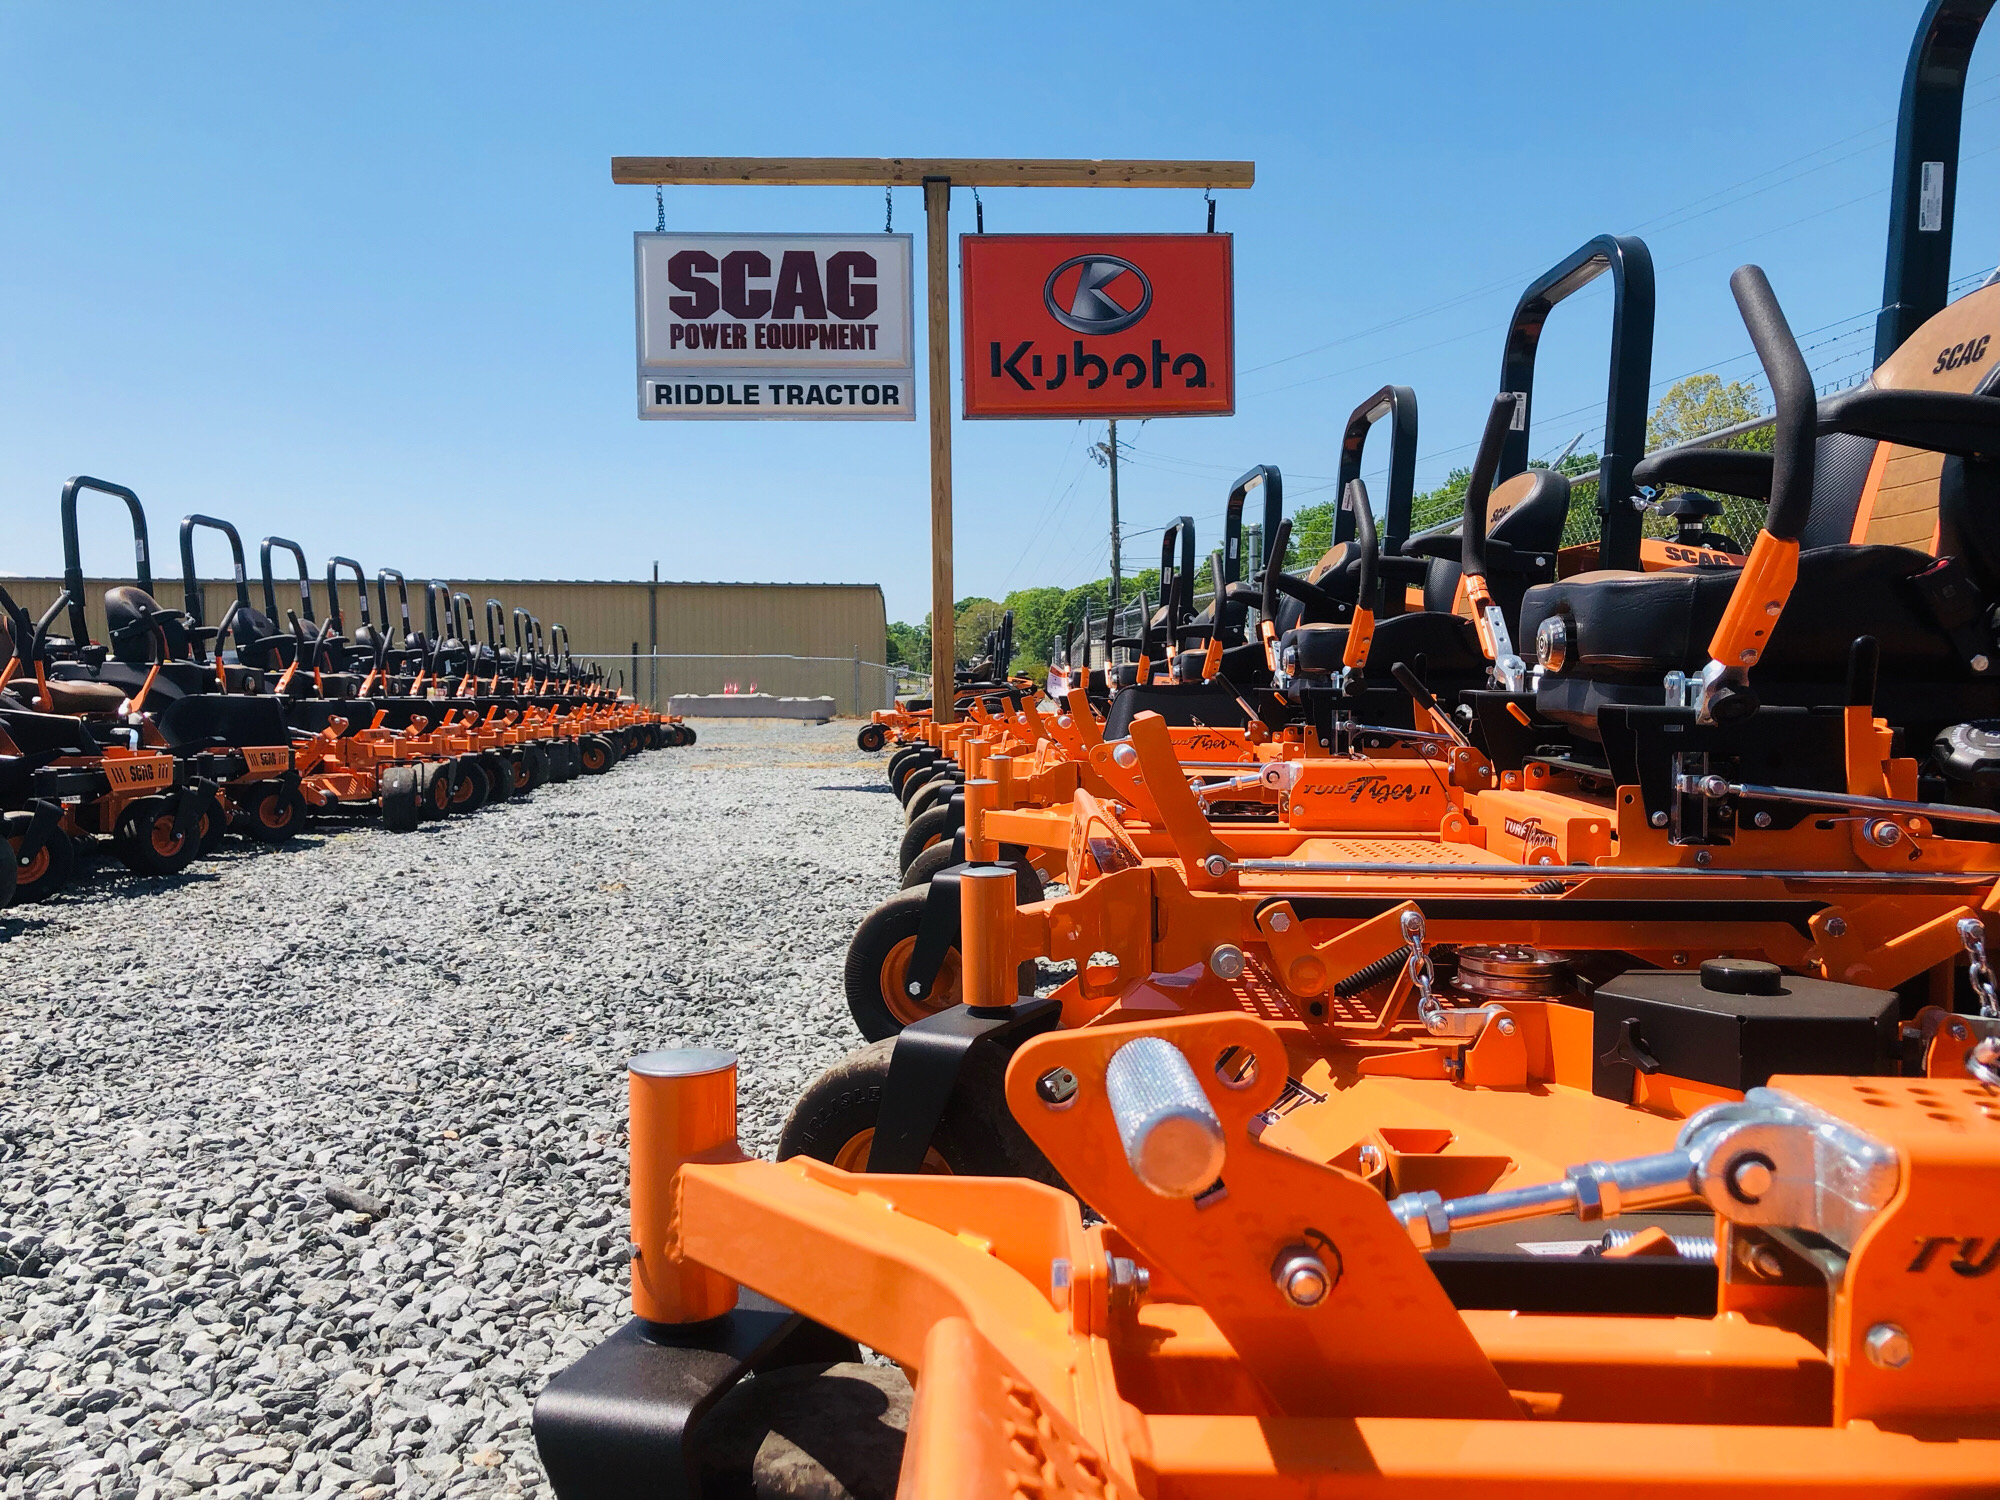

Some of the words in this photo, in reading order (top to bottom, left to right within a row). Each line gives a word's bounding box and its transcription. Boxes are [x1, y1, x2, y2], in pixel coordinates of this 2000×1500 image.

[668, 250, 878, 320] SCAG
[670, 323, 747, 349] POWER
[754, 323, 878, 350] EQUIPMENT
[990, 339, 1207, 390] Kubota
[1932, 334, 1991, 375] SCAG
[655, 384, 760, 405] RIDDLE
[768, 384, 899, 405] TRACTOR
[1188, 734, 1228, 751] Tiger
[129, 764, 154, 782] SCAG
[1303, 784, 1356, 795] TURF
[1349, 775, 1417, 804] Tiger
[1505, 819, 1527, 837] TURF
